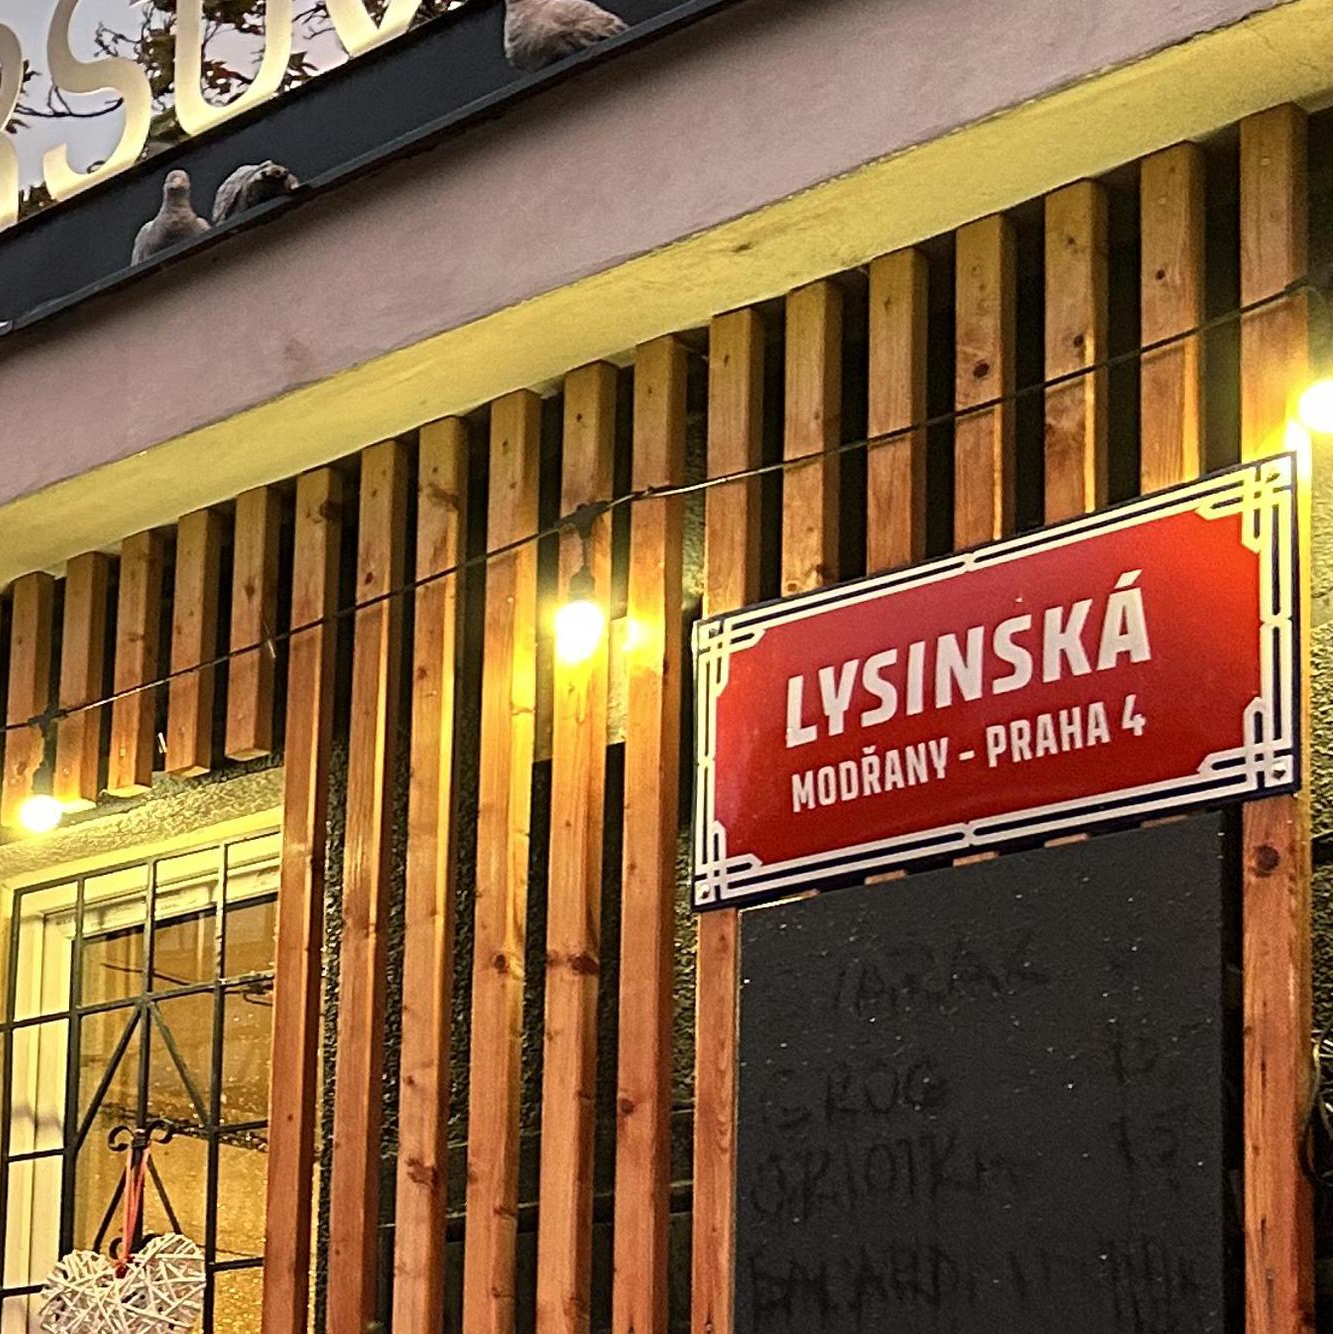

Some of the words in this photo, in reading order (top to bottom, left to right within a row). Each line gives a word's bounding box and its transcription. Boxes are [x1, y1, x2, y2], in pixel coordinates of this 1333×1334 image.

[786, 568, 1152, 748] LYSINSKÁ
[791, 737, 949, 812] MODŘANY
[986, 701, 1111, 768] PRAHA
[1121, 694, 1146, 736] 4
